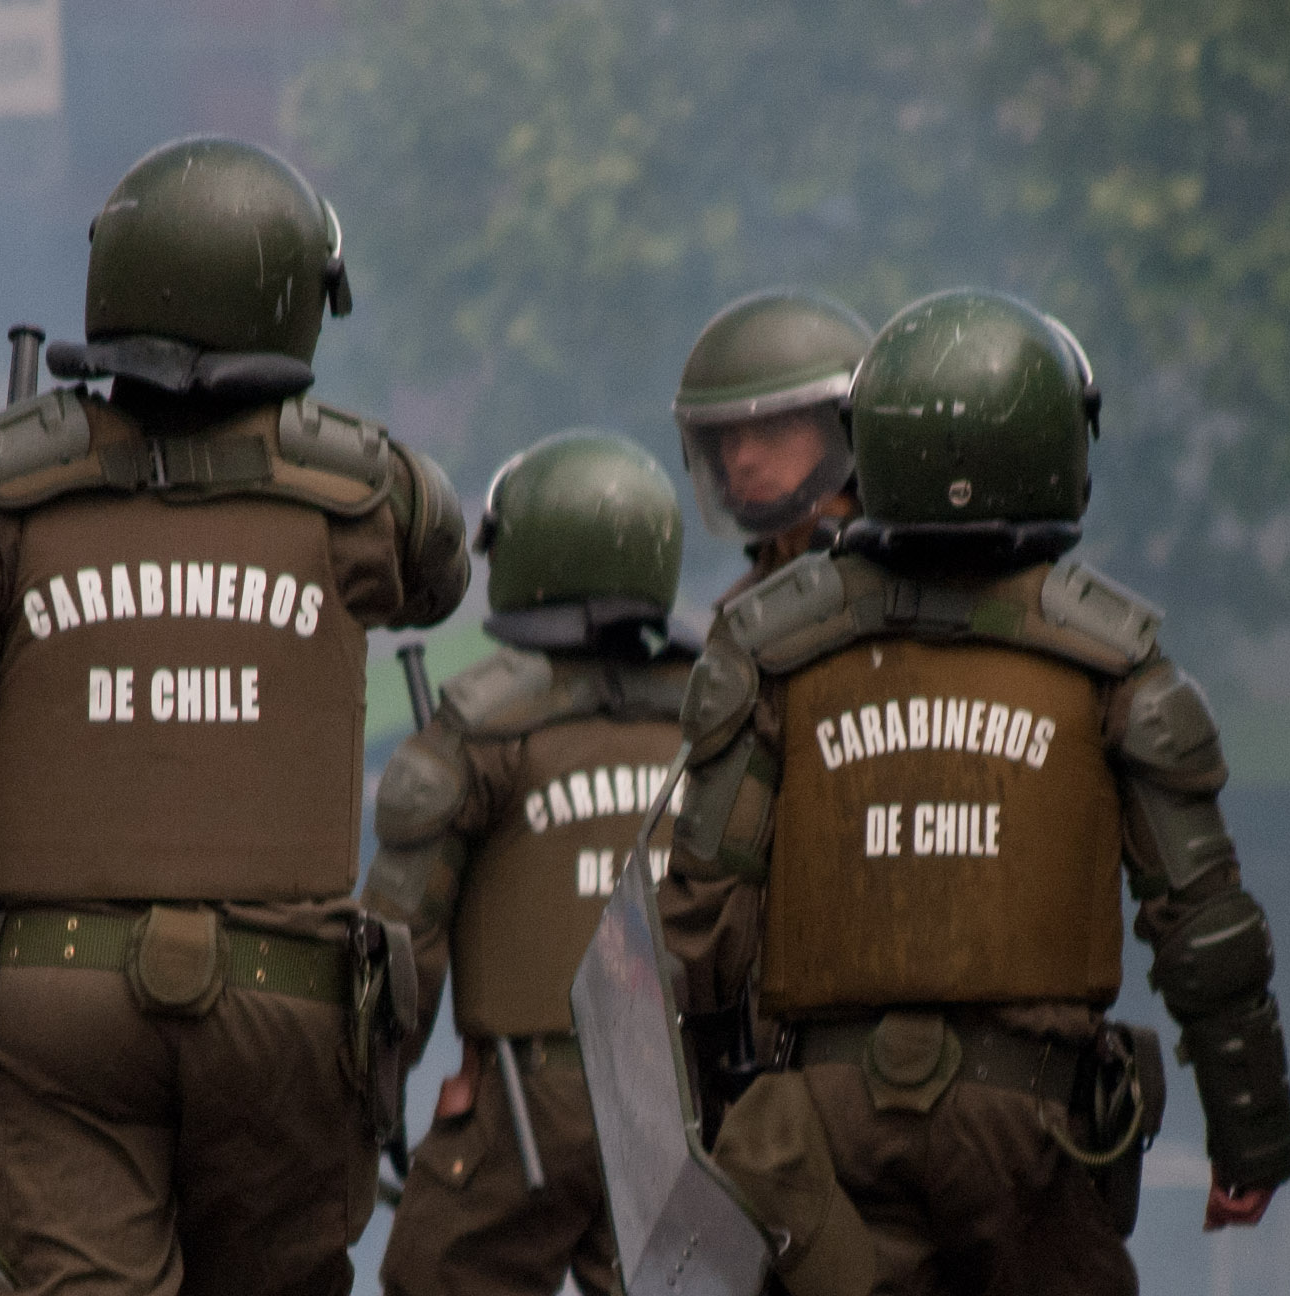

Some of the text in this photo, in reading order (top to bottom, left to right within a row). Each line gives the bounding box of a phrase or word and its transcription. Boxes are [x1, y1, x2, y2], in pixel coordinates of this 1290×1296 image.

[24, 561, 323, 640] CARABINEROS
[88, 666, 260, 722] DE CHILE
[816, 697, 1056, 771] CARABINEROS
[865, 803, 1001, 857] DE CHILE
[577, 848, 614, 896] DE
